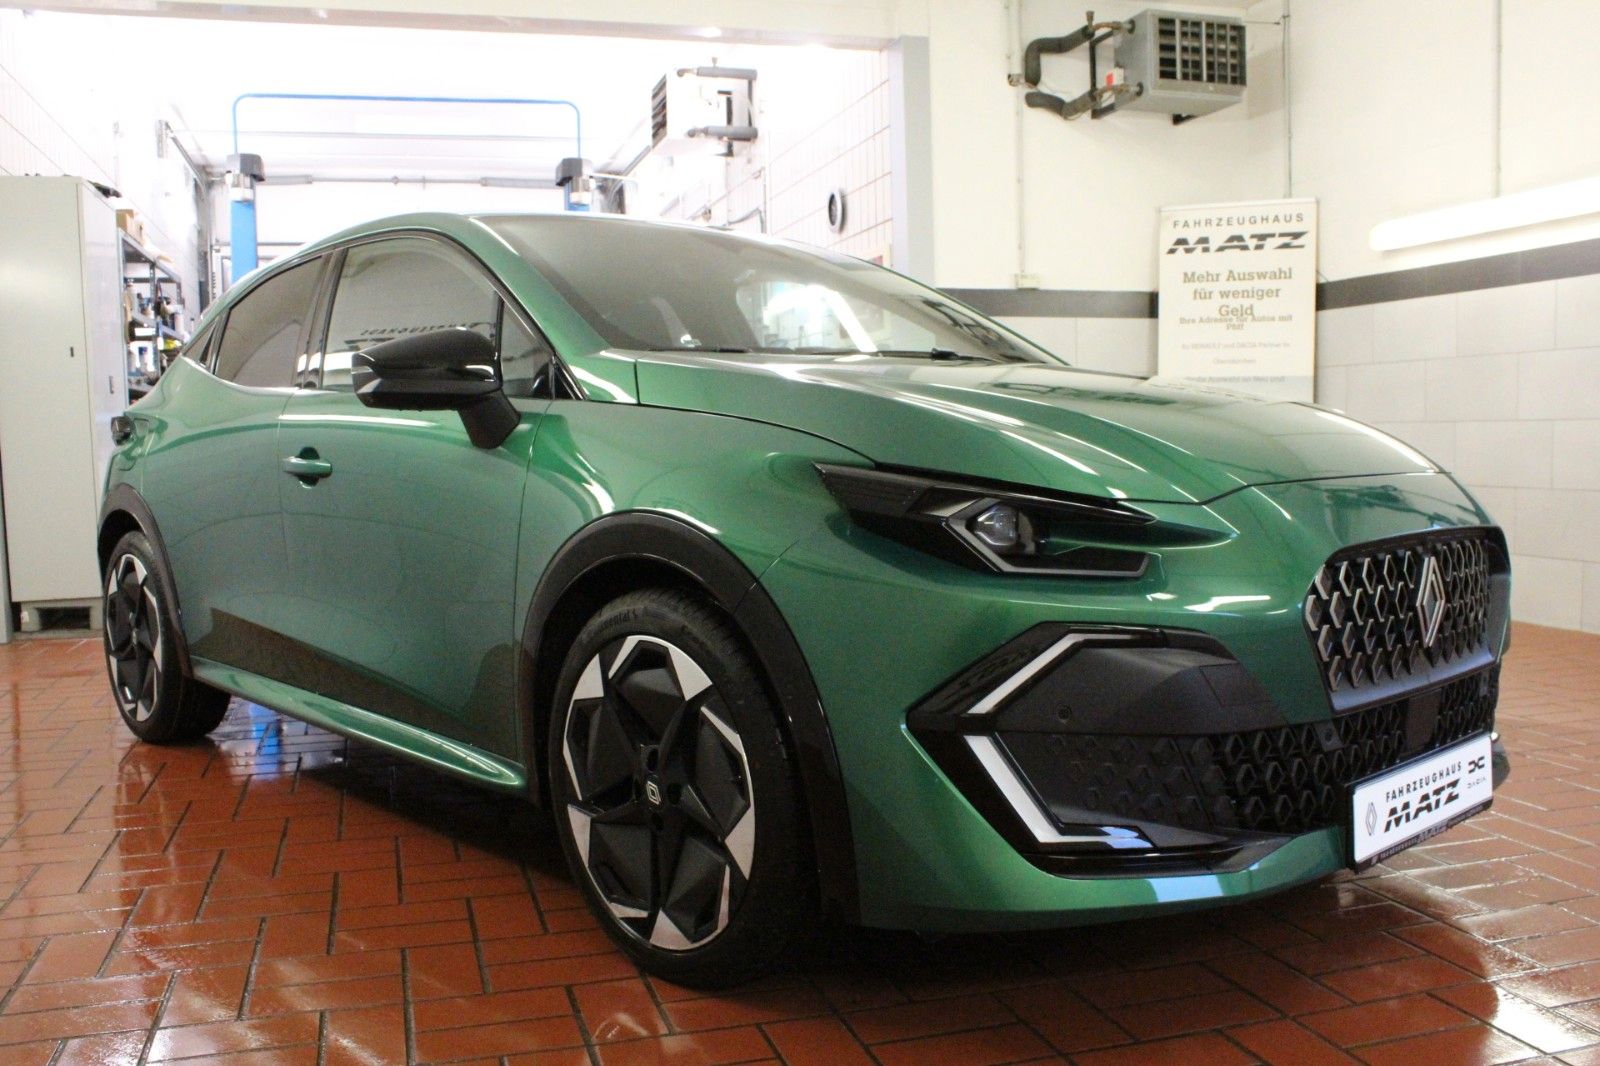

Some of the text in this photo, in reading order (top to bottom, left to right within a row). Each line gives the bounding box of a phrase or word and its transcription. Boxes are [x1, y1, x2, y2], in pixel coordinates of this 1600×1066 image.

[1173, 213, 1304, 229] FAHRZEUGHAUS
[1166, 231, 1309, 255] MATZ
[1182, 268, 1292, 284] Mehr Auswahl
[1193, 287, 1281, 300] für weniger
[1218, 304, 1254, 317] Geld
[1386, 761, 1462, 803] FAHRZEUGHAUS
[1384, 779, 1460, 833] MATZ
